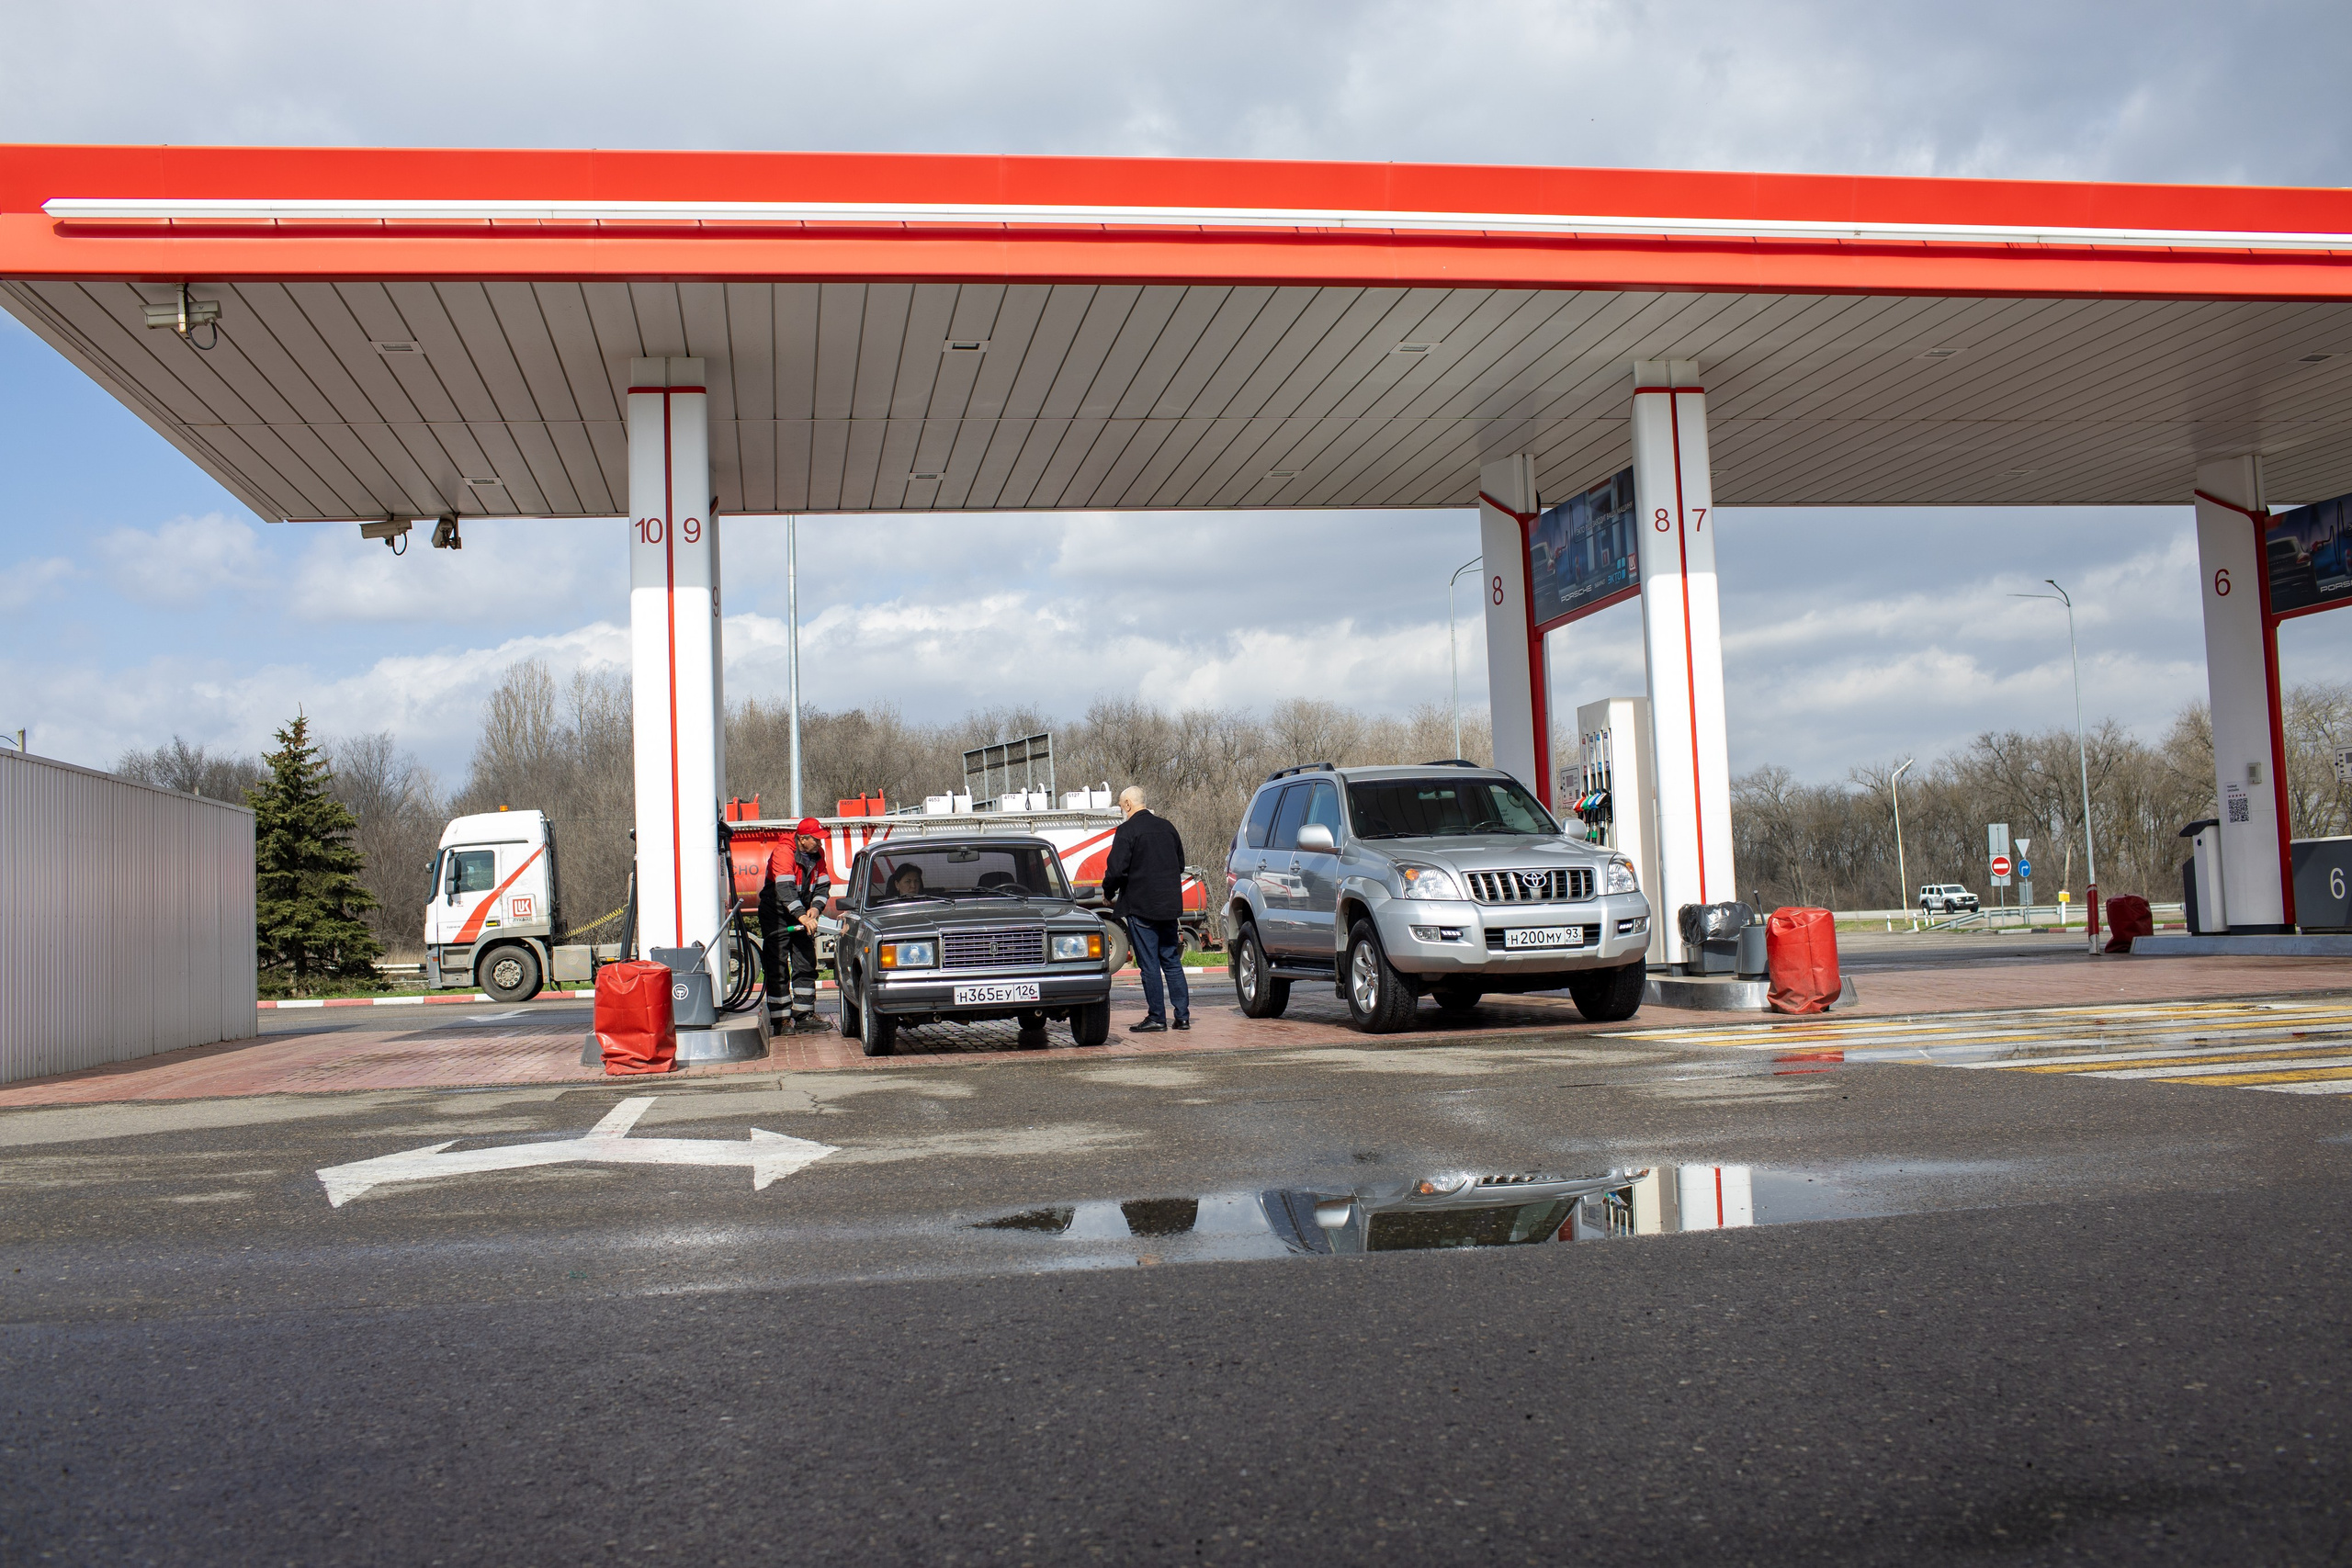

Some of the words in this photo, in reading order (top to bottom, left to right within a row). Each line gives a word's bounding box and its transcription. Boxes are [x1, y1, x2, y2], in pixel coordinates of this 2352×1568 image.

[635, 517, 663, 544] 10
[684, 517, 701, 544] 9
[1655, 508, 1670, 533] 8
[1691, 508, 1707, 532] 7
[1492, 575, 1504, 606] 8
[1561, 585, 1592, 603] PORSCHE
[2214, 569, 2232, 597] 6
[2320, 580, 2352, 593] PORS
[713, 586, 719, 617] 9
[2329, 867, 2346, 900] 6
[514, 899, 531, 915] LUK
[1566, 928, 1578, 939] 93
[1015, 985, 1035, 996] 126
